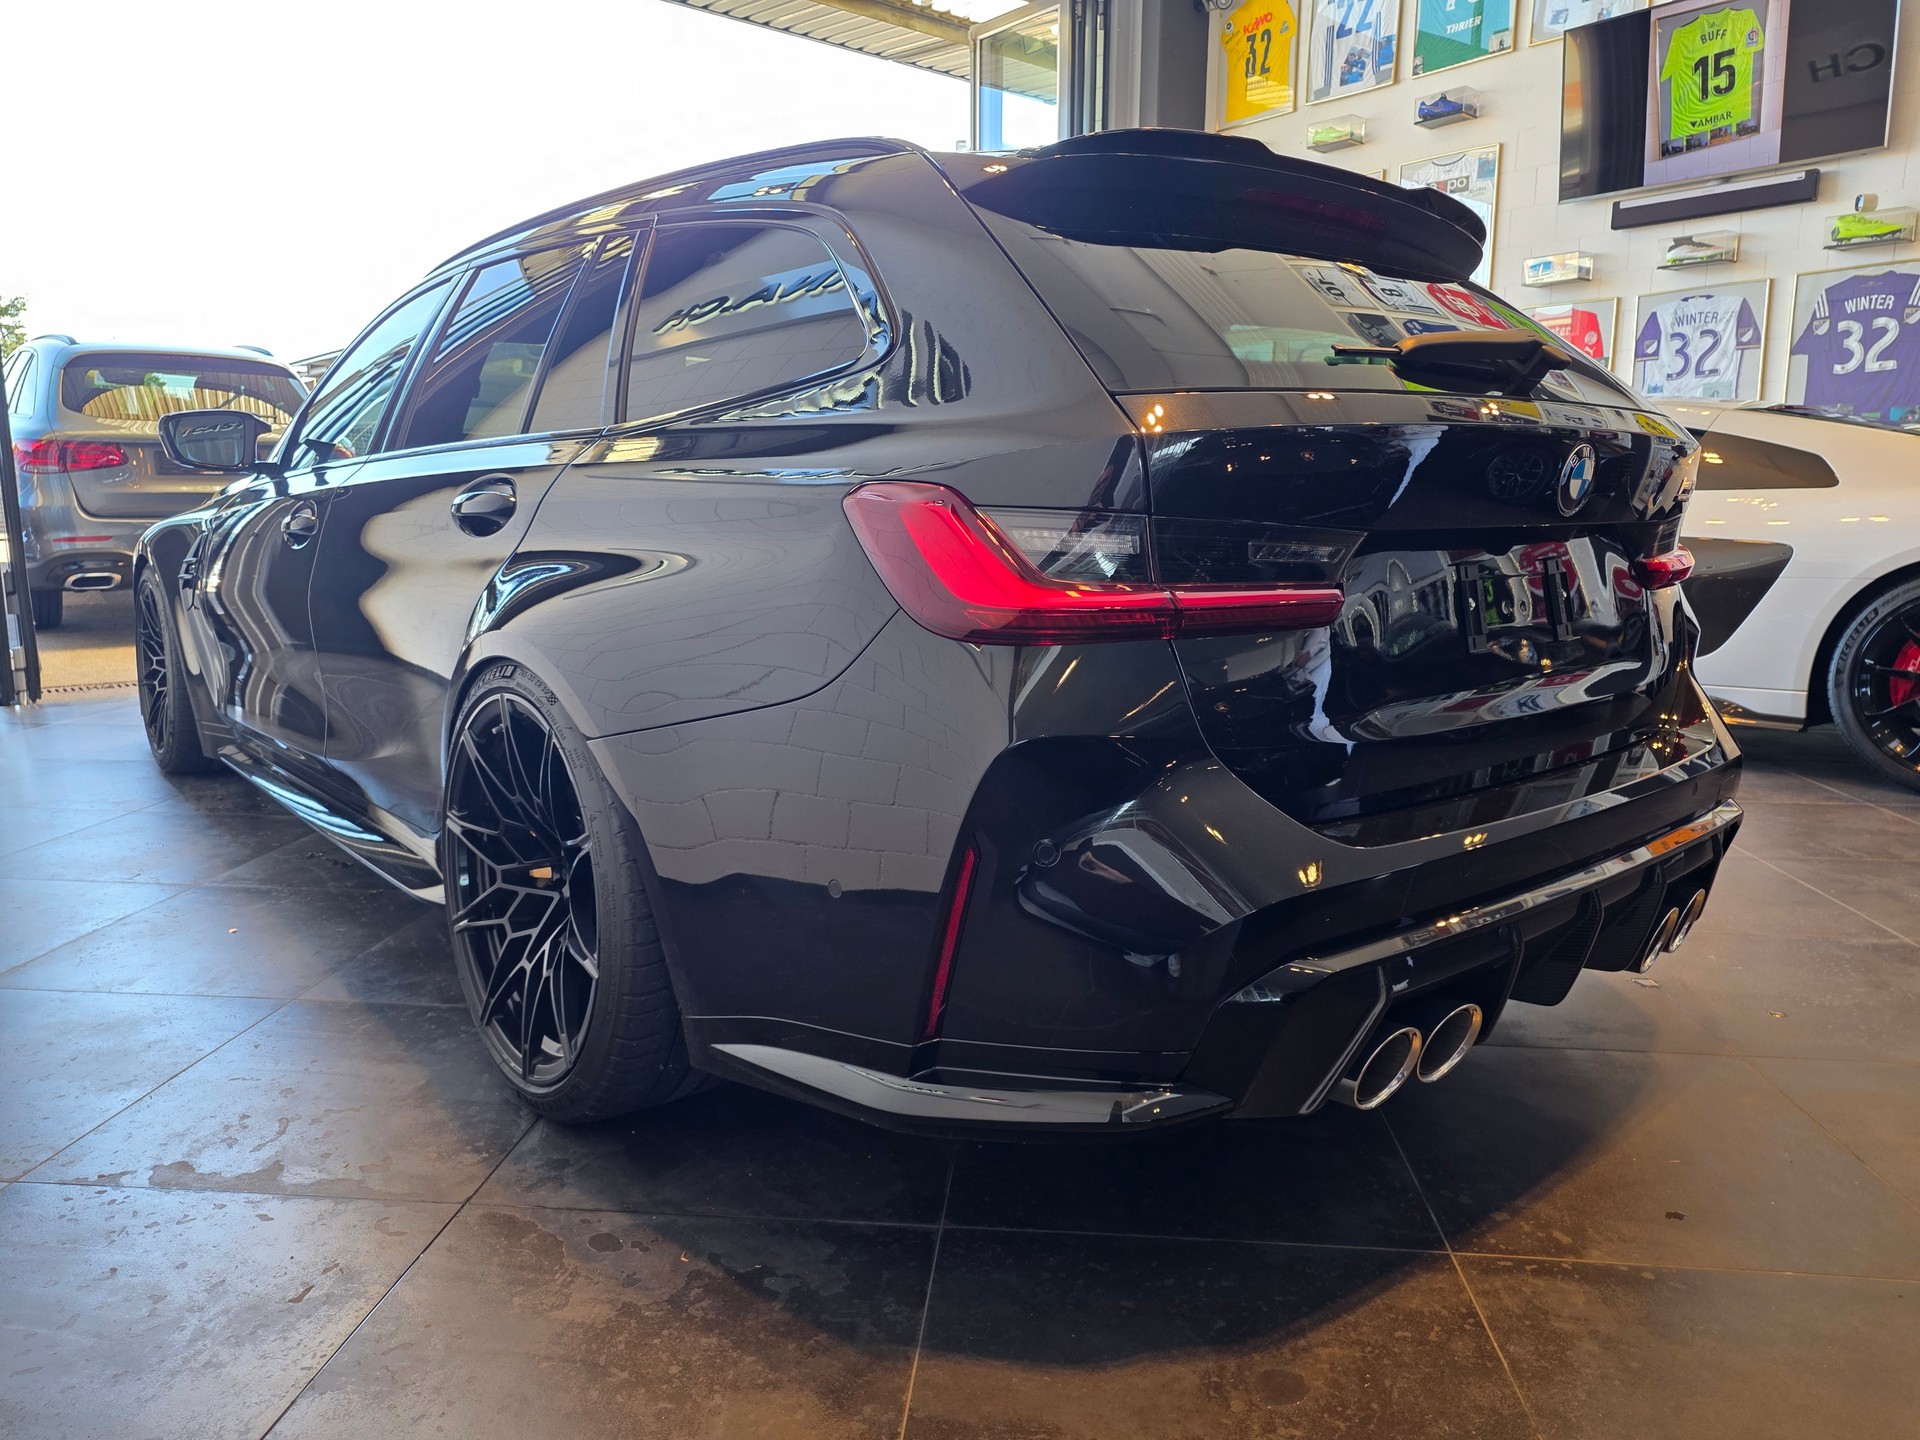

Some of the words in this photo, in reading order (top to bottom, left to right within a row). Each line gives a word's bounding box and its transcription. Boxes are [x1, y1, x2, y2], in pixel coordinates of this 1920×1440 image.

[1243, 12, 1273, 35] KAWO
[1336, 0, 1373, 39] 22
[1446, 16, 1482, 34] THRIER
[1700, 29, 1728, 45] BUFF
[1245, 28, 1272, 78] 32
[1692, 47, 1736, 102] 15
[1698, 111, 1733, 128] AMBAR
[1845, 294, 1895, 314] WINTER
[1675, 311, 1719, 328] WINTER
[1665, 328, 1722, 382] 32
[1832, 316, 1900, 375] 32
